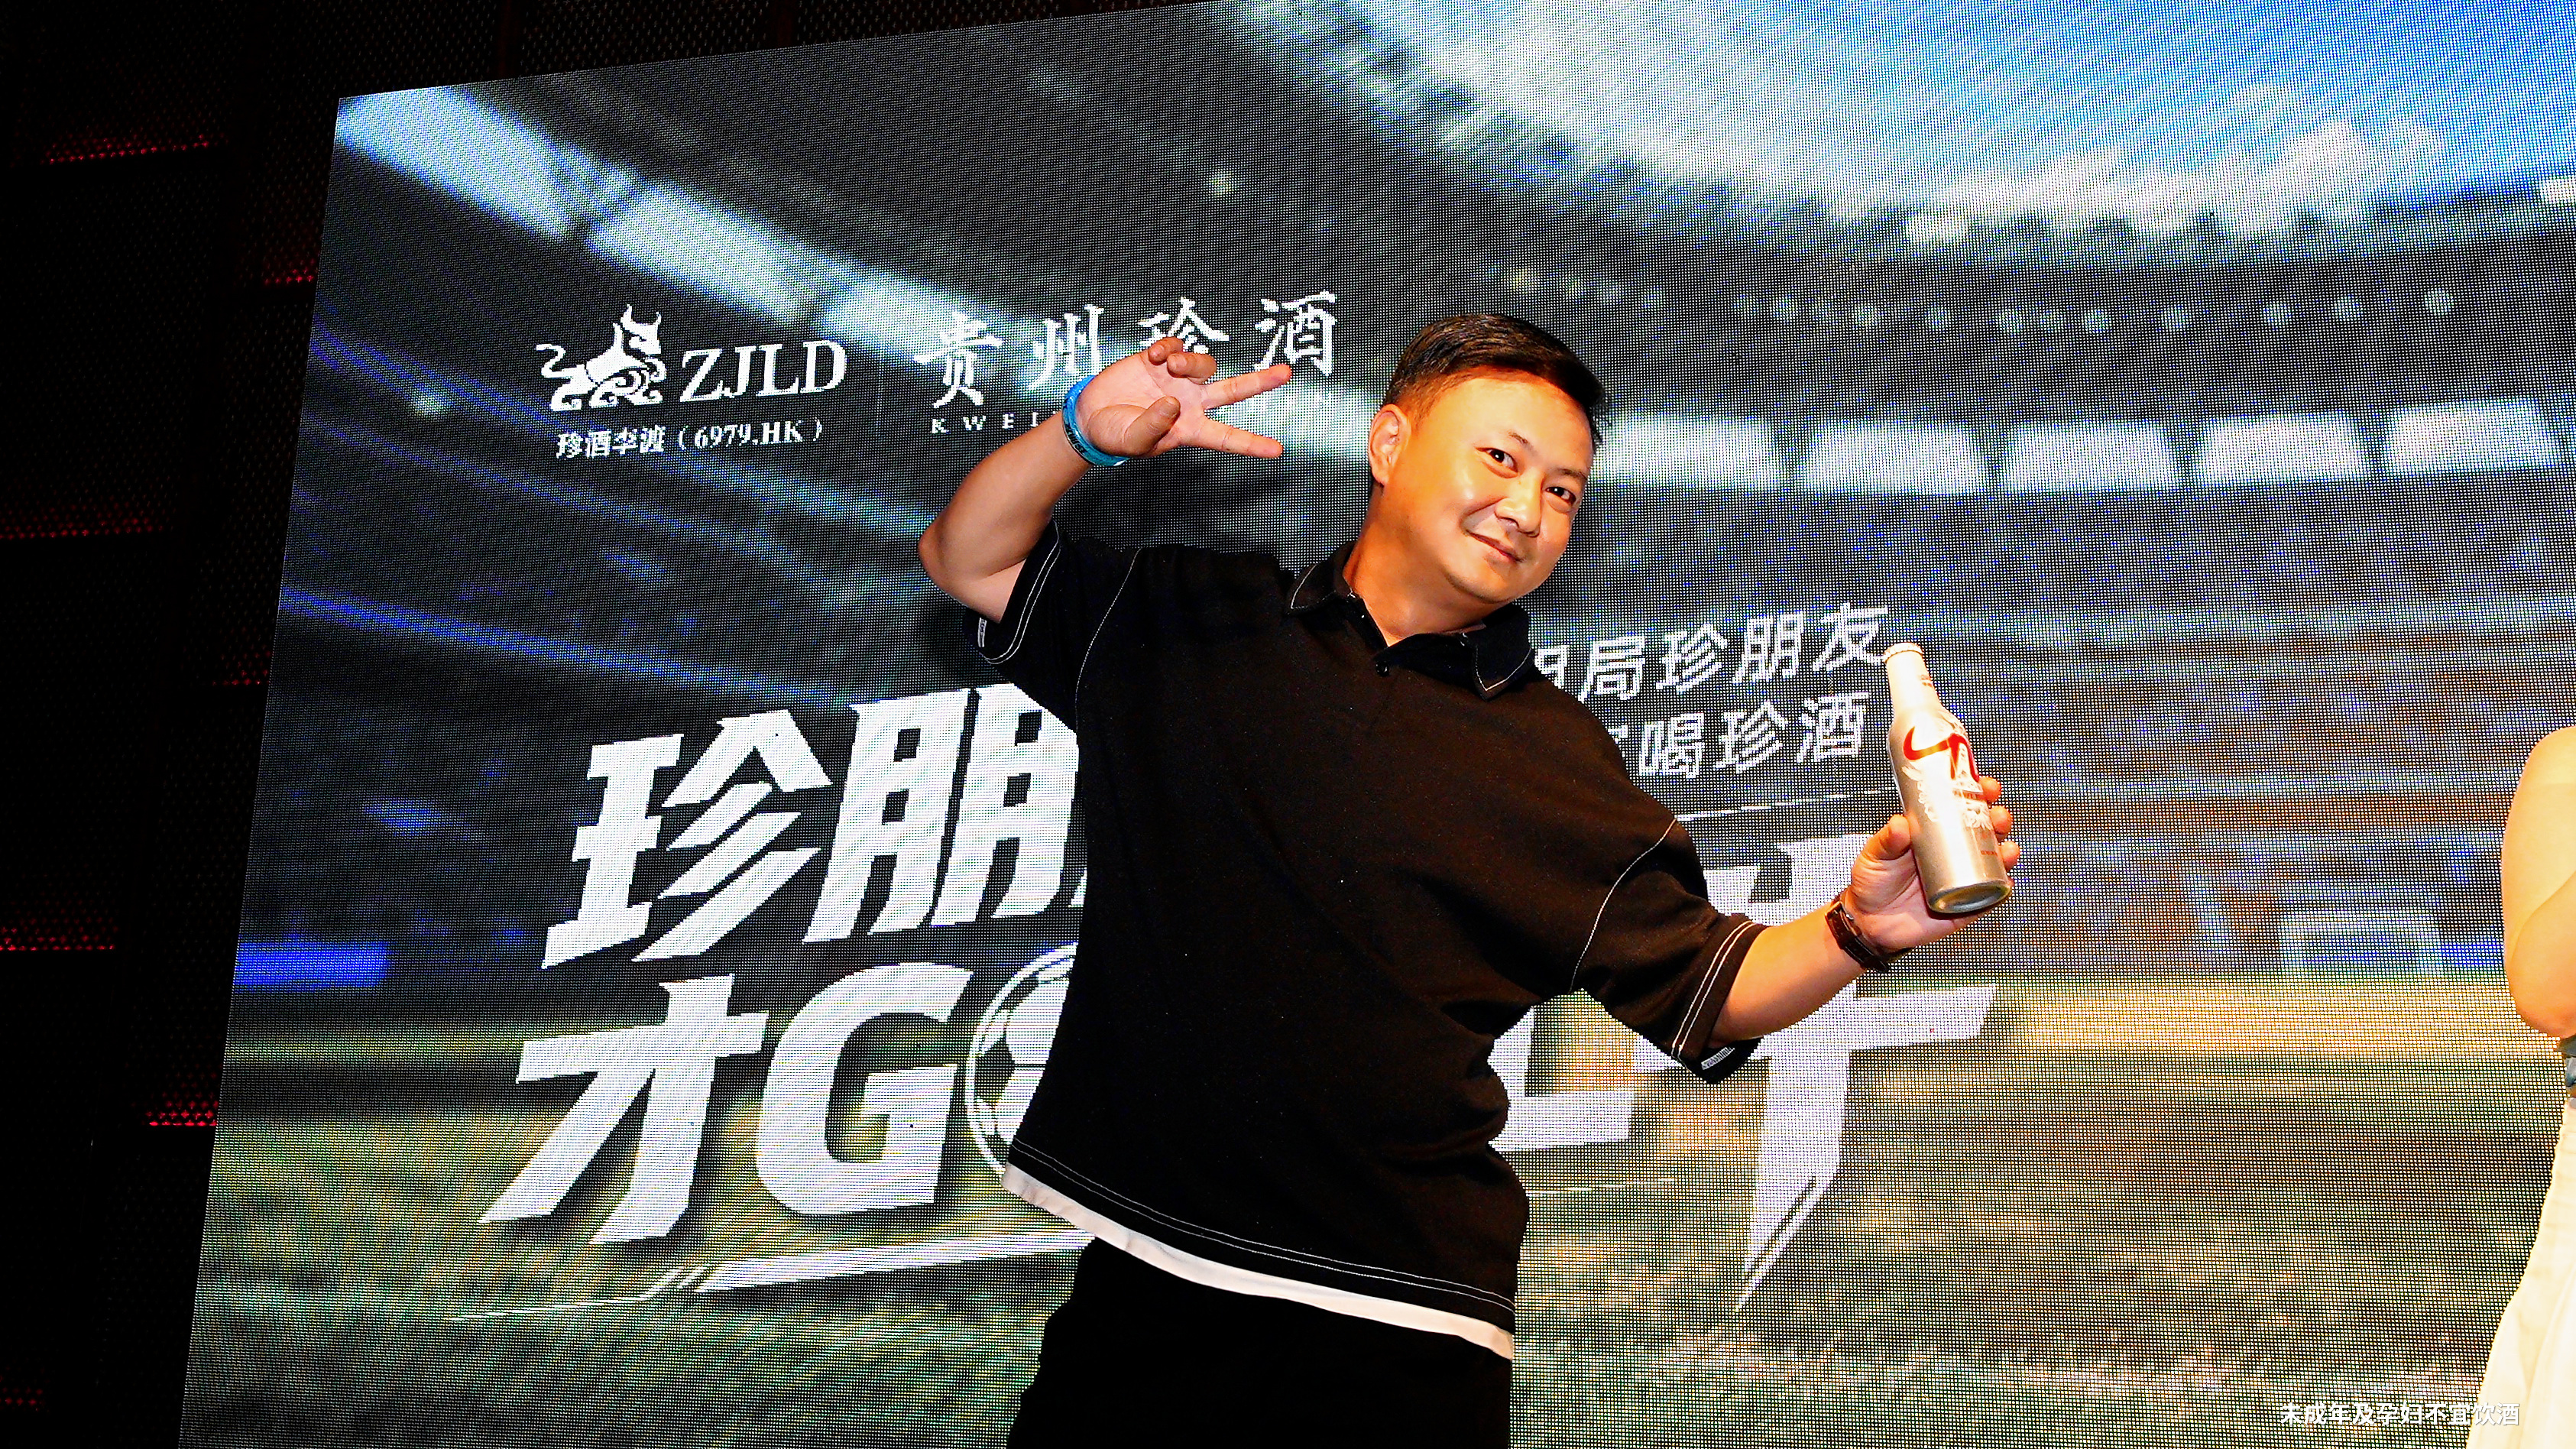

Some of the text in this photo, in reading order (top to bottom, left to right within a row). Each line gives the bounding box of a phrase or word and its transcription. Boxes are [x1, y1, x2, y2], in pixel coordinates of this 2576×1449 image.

[679, 339, 848, 404] ZJLD
[932, 411, 1056, 434] KWEI
[1608, 691, 1869, 779] 喝珍酒
[542, 683, 1087, 969] 珍朋
